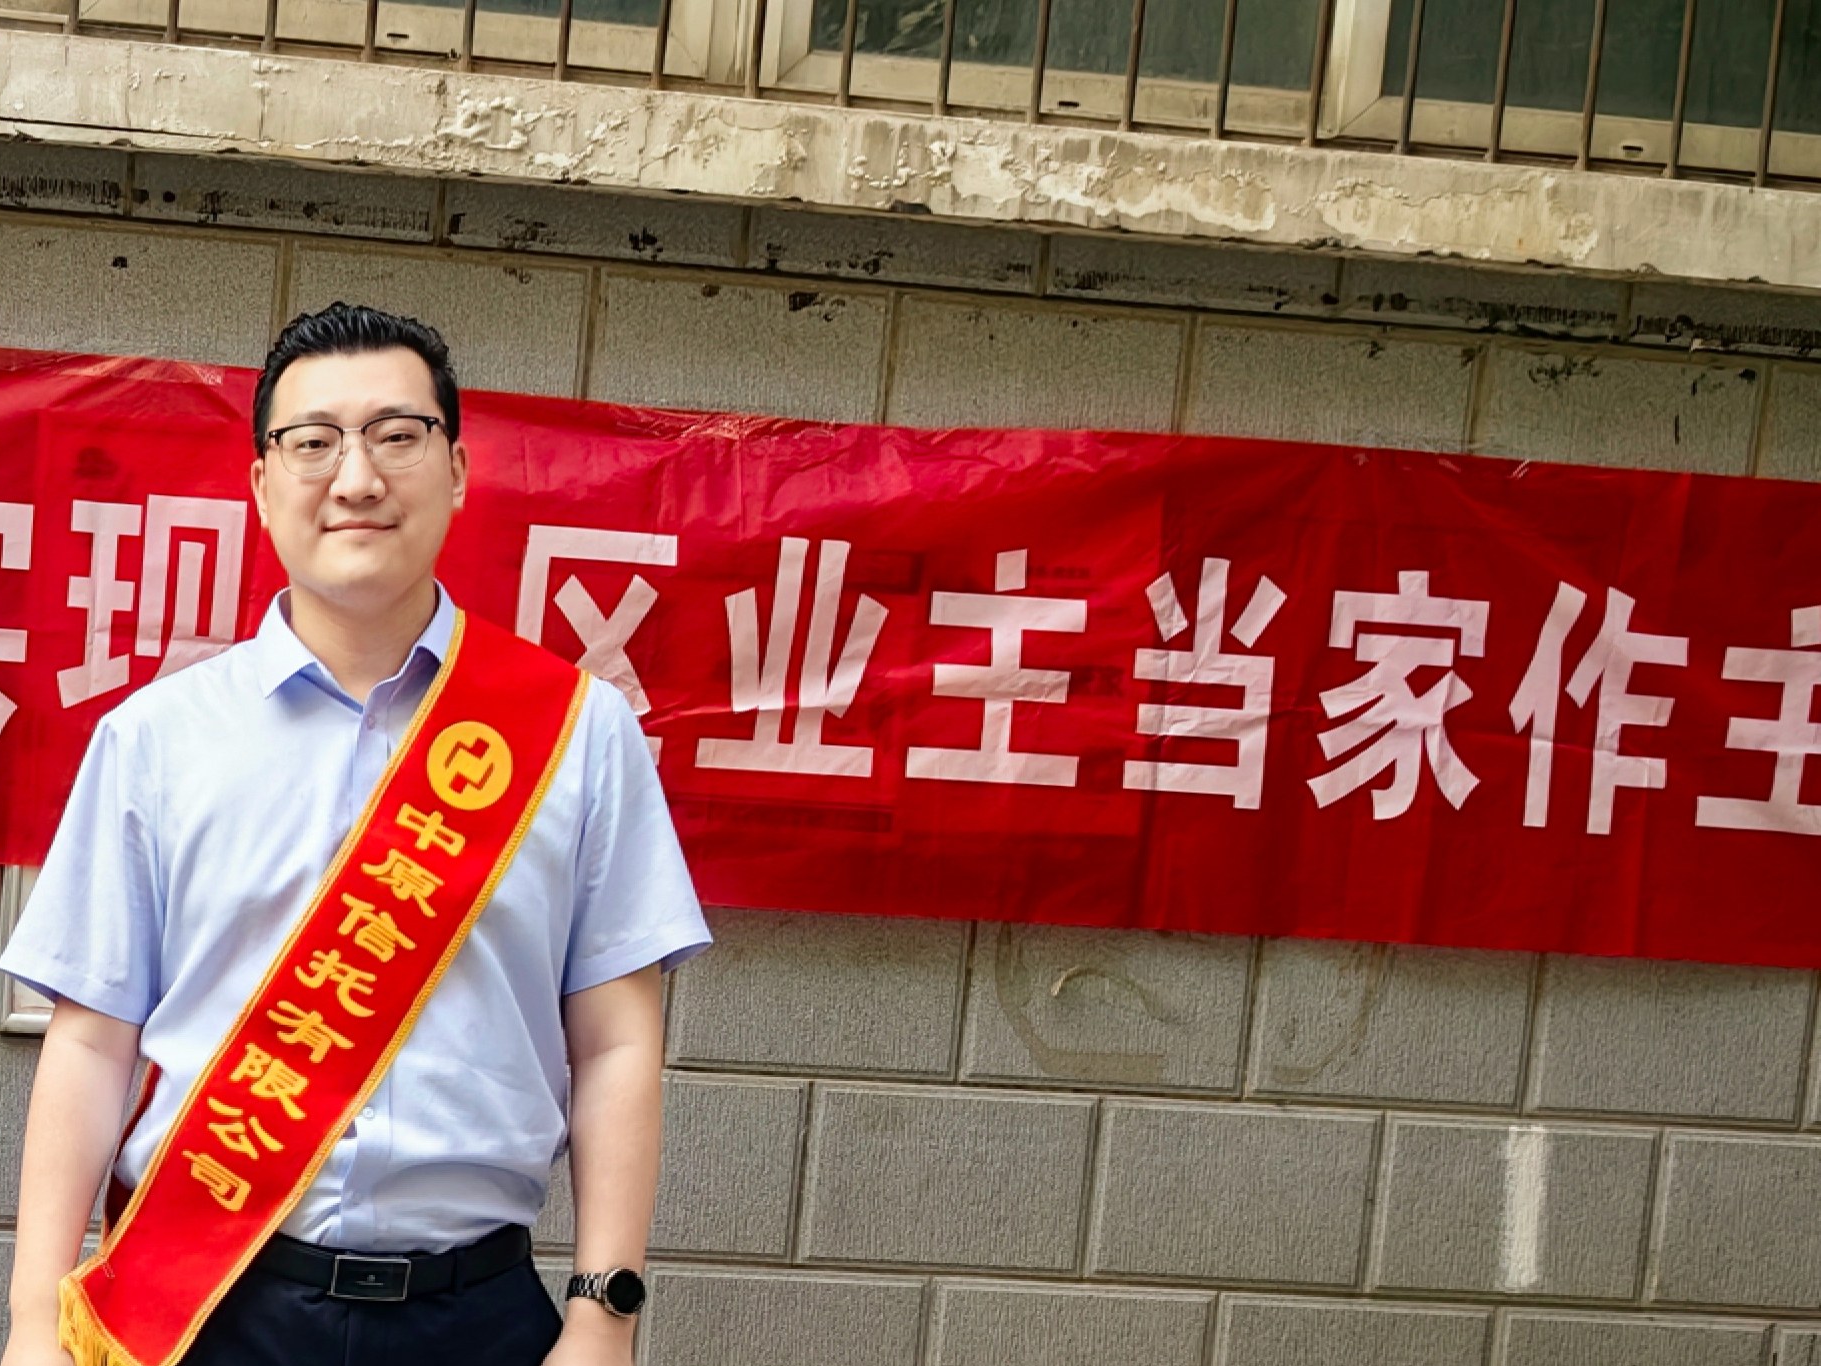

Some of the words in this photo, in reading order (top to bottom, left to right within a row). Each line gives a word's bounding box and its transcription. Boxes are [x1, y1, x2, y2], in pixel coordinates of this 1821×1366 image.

[182, 802, 465, 1212] 中原信托有限公司
